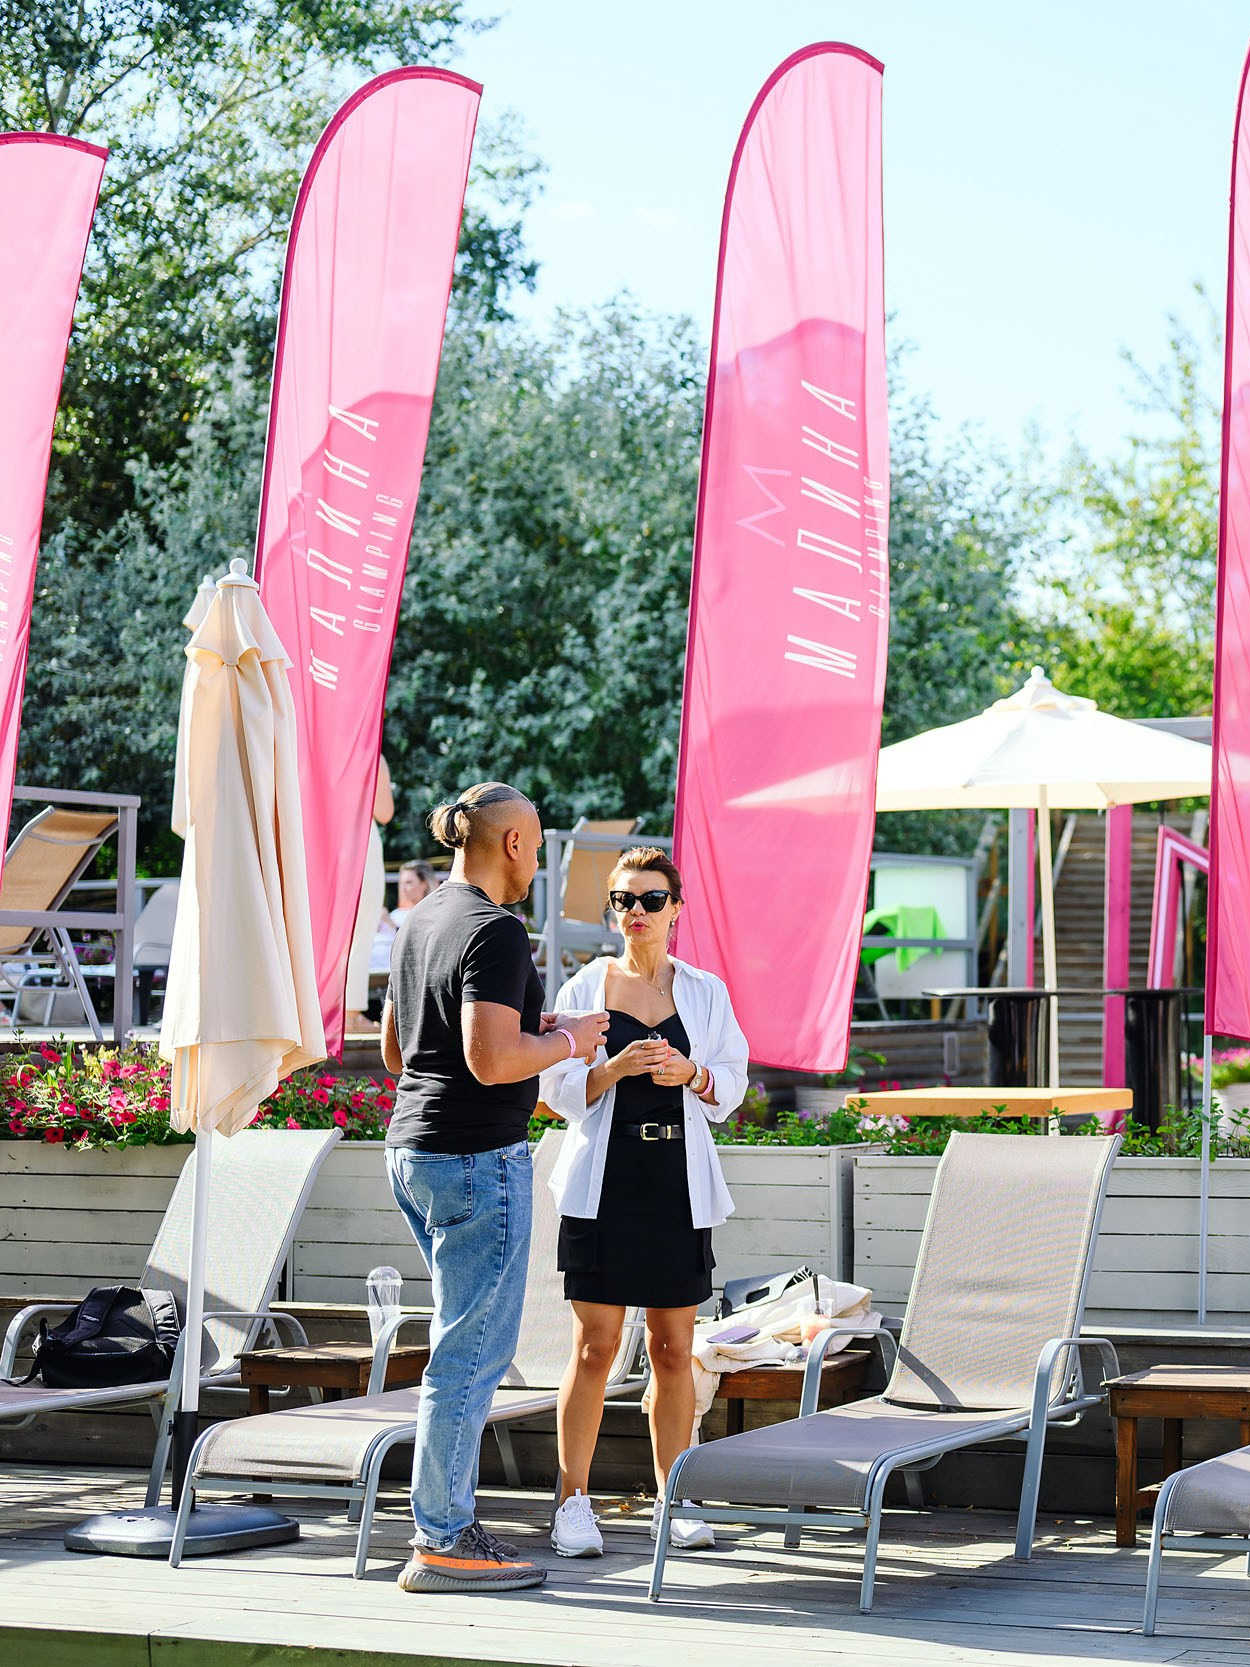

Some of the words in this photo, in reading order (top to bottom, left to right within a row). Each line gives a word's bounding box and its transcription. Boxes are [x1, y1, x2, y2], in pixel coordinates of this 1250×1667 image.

[307, 404, 380, 691] МАЛИНА
[352, 493, 404, 633] GLAMPING
[784, 379, 863, 679] МАЛИНА
[863, 476, 886, 619] GLAMPING
